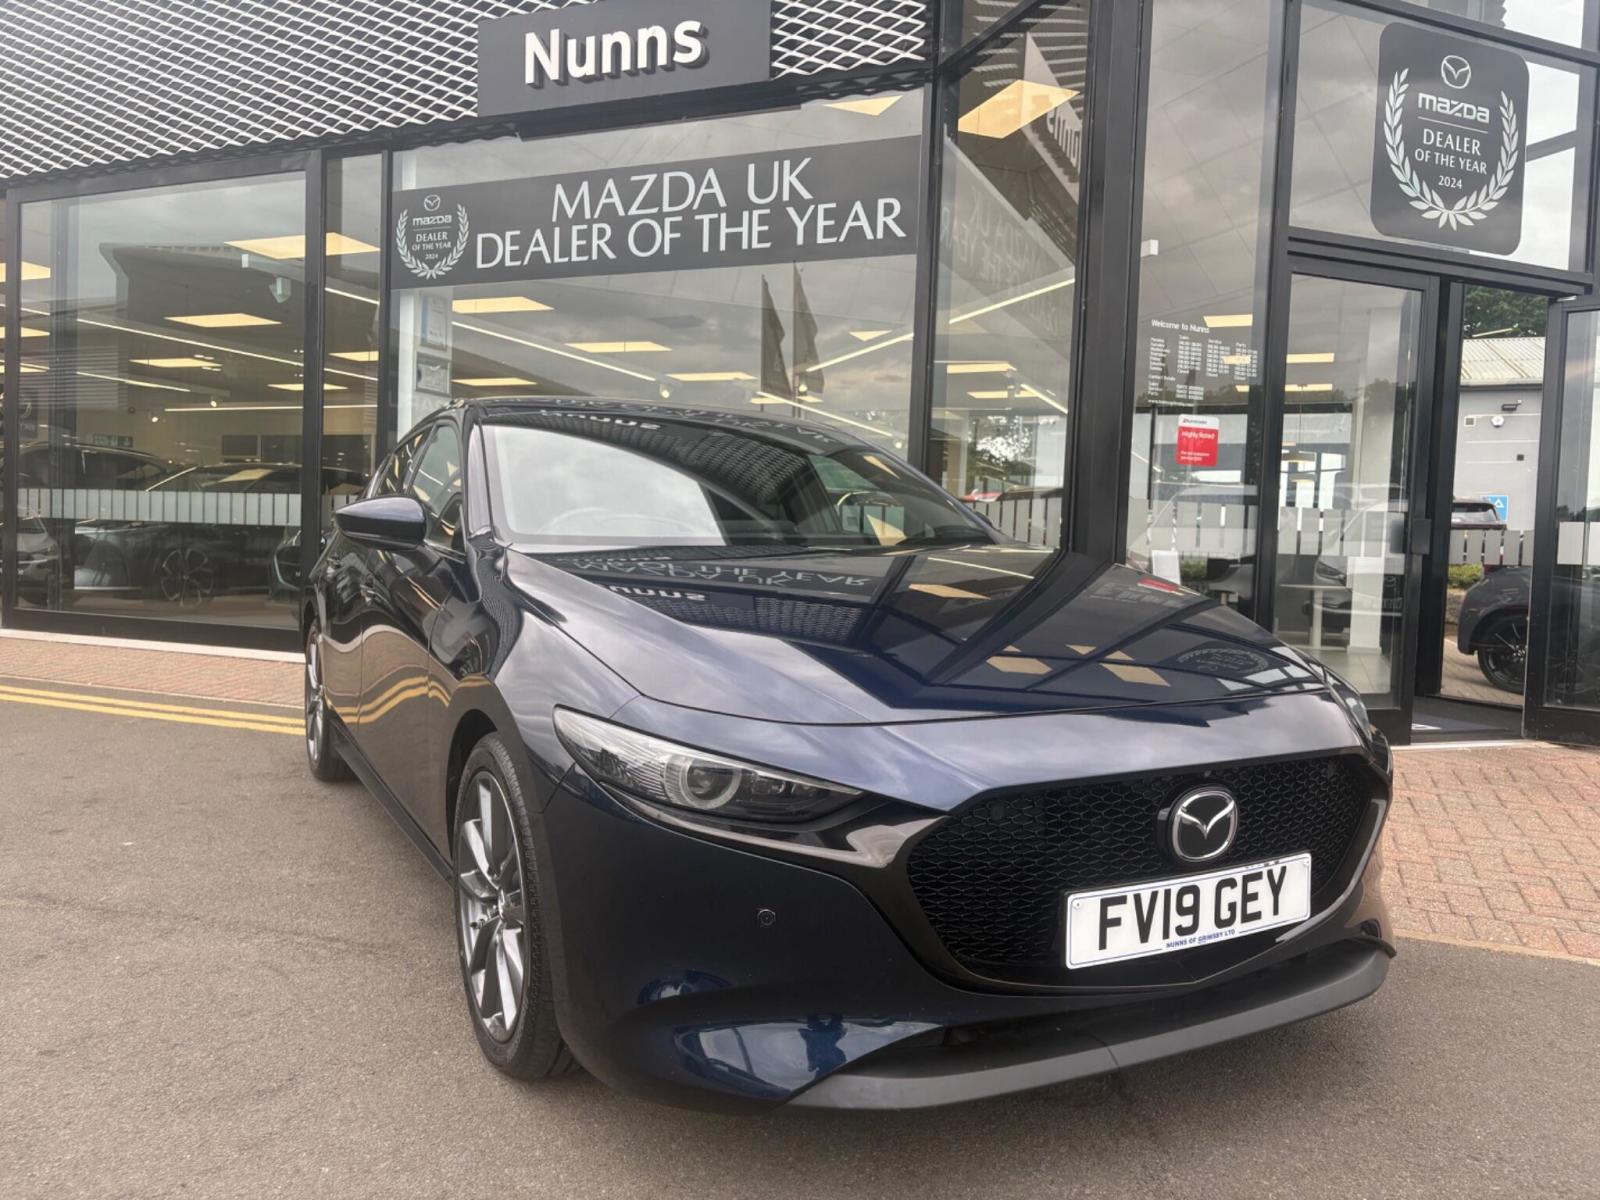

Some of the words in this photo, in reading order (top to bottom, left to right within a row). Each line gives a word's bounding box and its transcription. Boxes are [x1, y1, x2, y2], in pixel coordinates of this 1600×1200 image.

[524, 19, 704, 86] Nunns
[1418, 92, 1490, 124] mazda
[1423, 128, 1481, 156] DEALER
[1415, 148, 1431, 163] OF
[1434, 151, 1455, 168] THE
[1458, 157, 1487, 175] YEAR
[552, 167, 726, 222] MAZDA
[747, 158, 814, 205] UK
[1437, 175, 1463, 190] 2024
[412, 215, 452, 226] mazda
[476, 222, 616, 269] DEALER
[628, 215, 684, 258] OF
[694, 209, 772, 254] THE
[786, 198, 907, 245] YEAR
[416, 232, 448, 242] DEALER
[1151, 319, 1180, 330] Welcome
[1181, 323, 1189, 331] to
[1190, 324, 1210, 334] Nunns
[1098, 884, 1201, 951] FV19
[1213, 866, 1287, 930] GEY
[1166, 938, 1188, 948] NUNNS
[1189, 936, 1197, 944] OF
[1224, 928, 1236, 936] LTD
